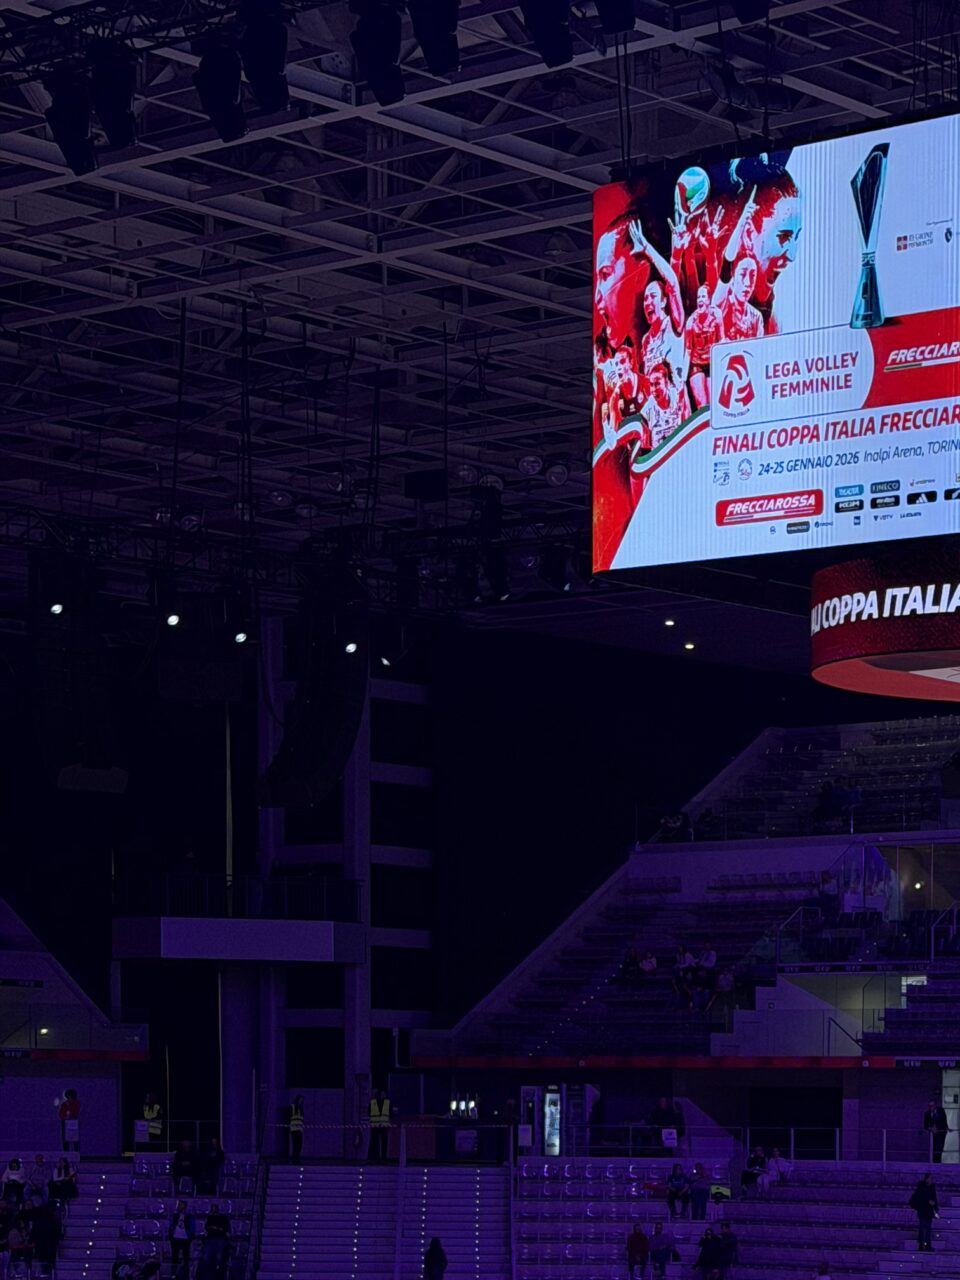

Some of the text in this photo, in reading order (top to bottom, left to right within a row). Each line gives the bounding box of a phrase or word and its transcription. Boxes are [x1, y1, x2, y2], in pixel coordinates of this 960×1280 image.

[765, 351, 859, 380] LEGA VOLLEY
[771, 373, 852, 399] FEMMINILE
[712, 431, 765, 456] FINALI
[767, 424, 820, 449] COPPA
[824, 416, 875, 441] ITALIA
[758, 461, 784, 475] 24-25
[786, 455, 833, 472] GENNAIO
[834, 452, 860, 466] 2026
[863, 450, 890, 464] Inalpi
[893, 446, 924, 458] Arena,
[726, 494, 815, 515] FRECCIAROSSA
[822, 590, 879, 629] COPPA
